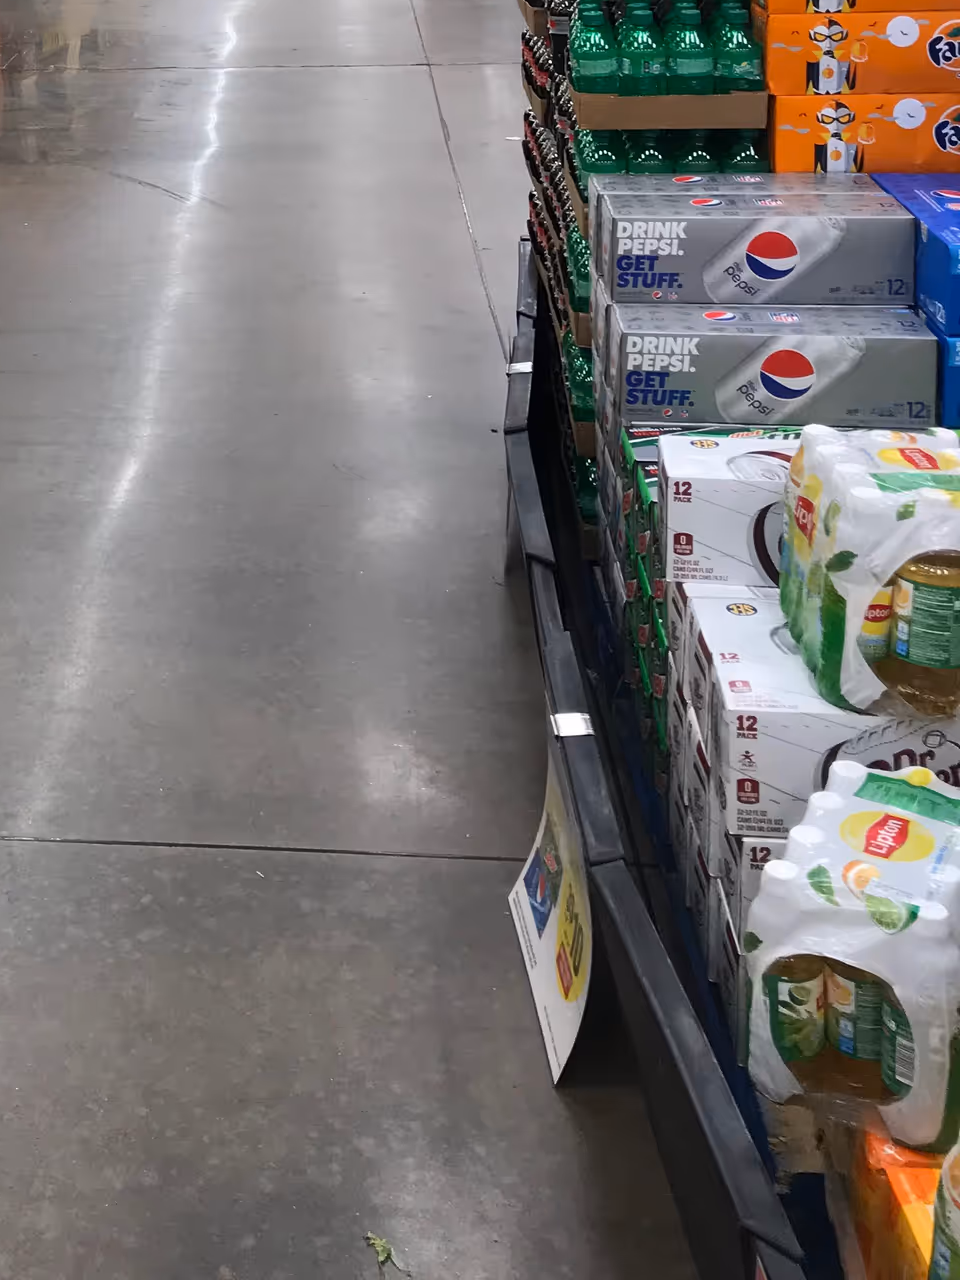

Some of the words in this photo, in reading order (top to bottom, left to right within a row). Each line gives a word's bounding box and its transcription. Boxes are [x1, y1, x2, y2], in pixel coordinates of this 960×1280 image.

[616, 221, 687, 238] DRINK
[617, 239, 684, 256] PEPSI.
[616, 255, 659, 271] GET
[616, 272, 683, 289] STUFF.
[723, 265, 760, 297] pepsi
[887, 279, 905, 296] 12
[626, 336, 700, 355] DRINK
[627, 354, 696, 372] PEPSI.
[625, 371, 669, 389] GET
[626, 389, 695, 407] STUFF.
[736, 384, 776, 418] pepsi
[907, 401, 926, 418] 12
[903, 448, 933, 470] Lipton
[673, 481, 692, 496] 12
[680, 535, 686, 545] 0
[736, 715, 758, 731] 12
[869, 818, 904, 854] Lipton
[750, 846, 771, 863] 12
